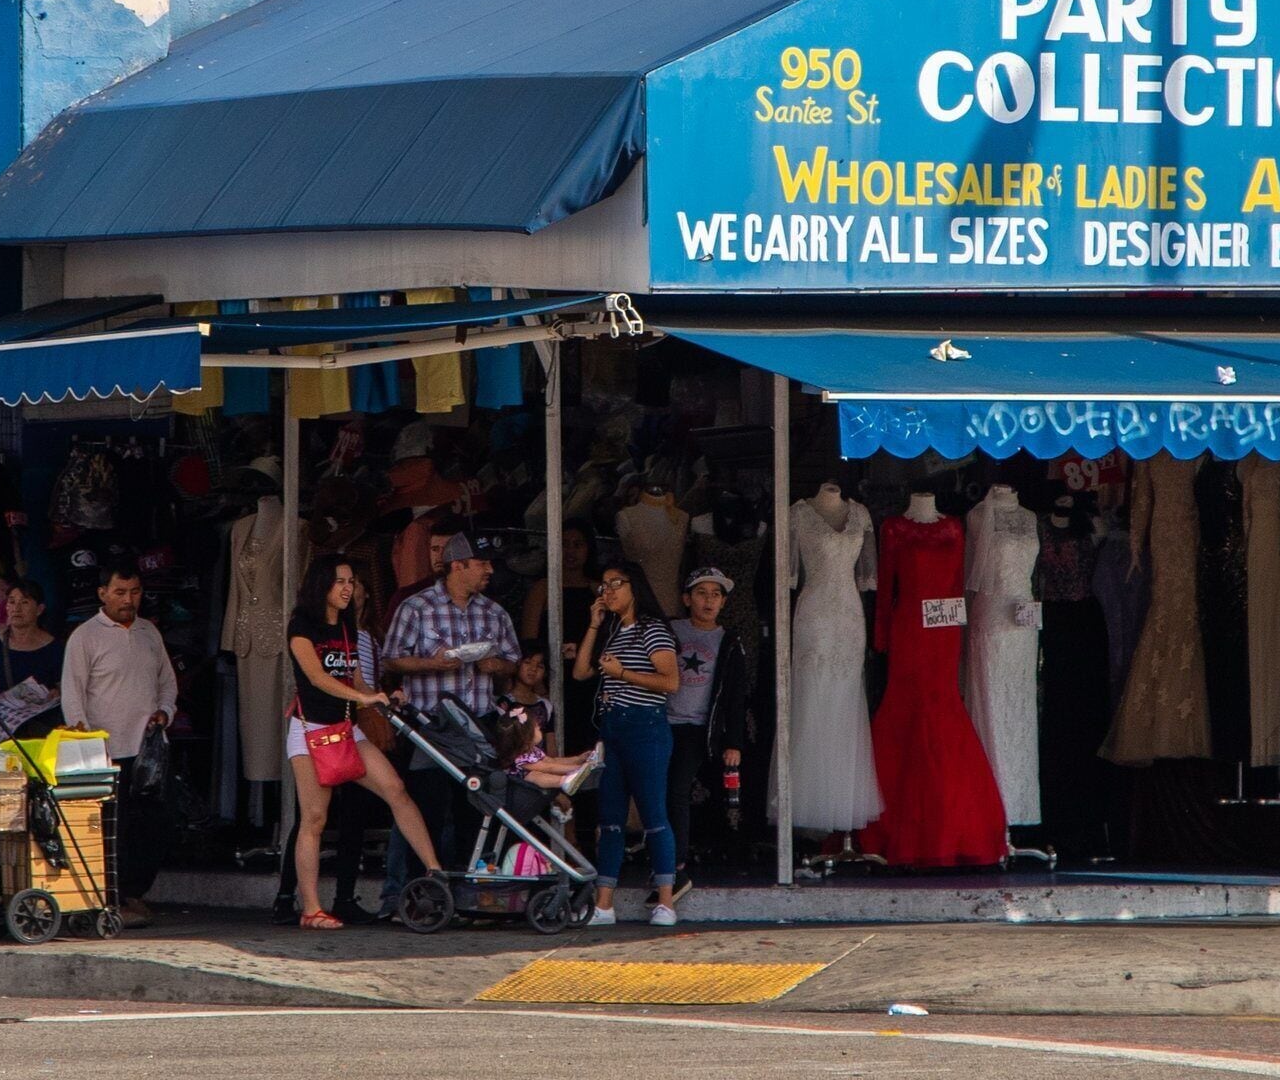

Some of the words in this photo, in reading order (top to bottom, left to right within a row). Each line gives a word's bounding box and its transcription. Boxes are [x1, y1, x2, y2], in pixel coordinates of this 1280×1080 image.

[780, 47, 861, 91] 950
[754, 86, 835, 126] Santee
[772, 145, 1043, 208] WHOLESALER
[1075, 161, 1207, 211] LADIES
[677, 210, 741, 262] WE
[742, 215, 850, 265] CARRY
[858, 215, 937, 265] ALL
[949, 216, 1049, 266] SIZES
[1084, 218, 1251, 268] DESIGNER
